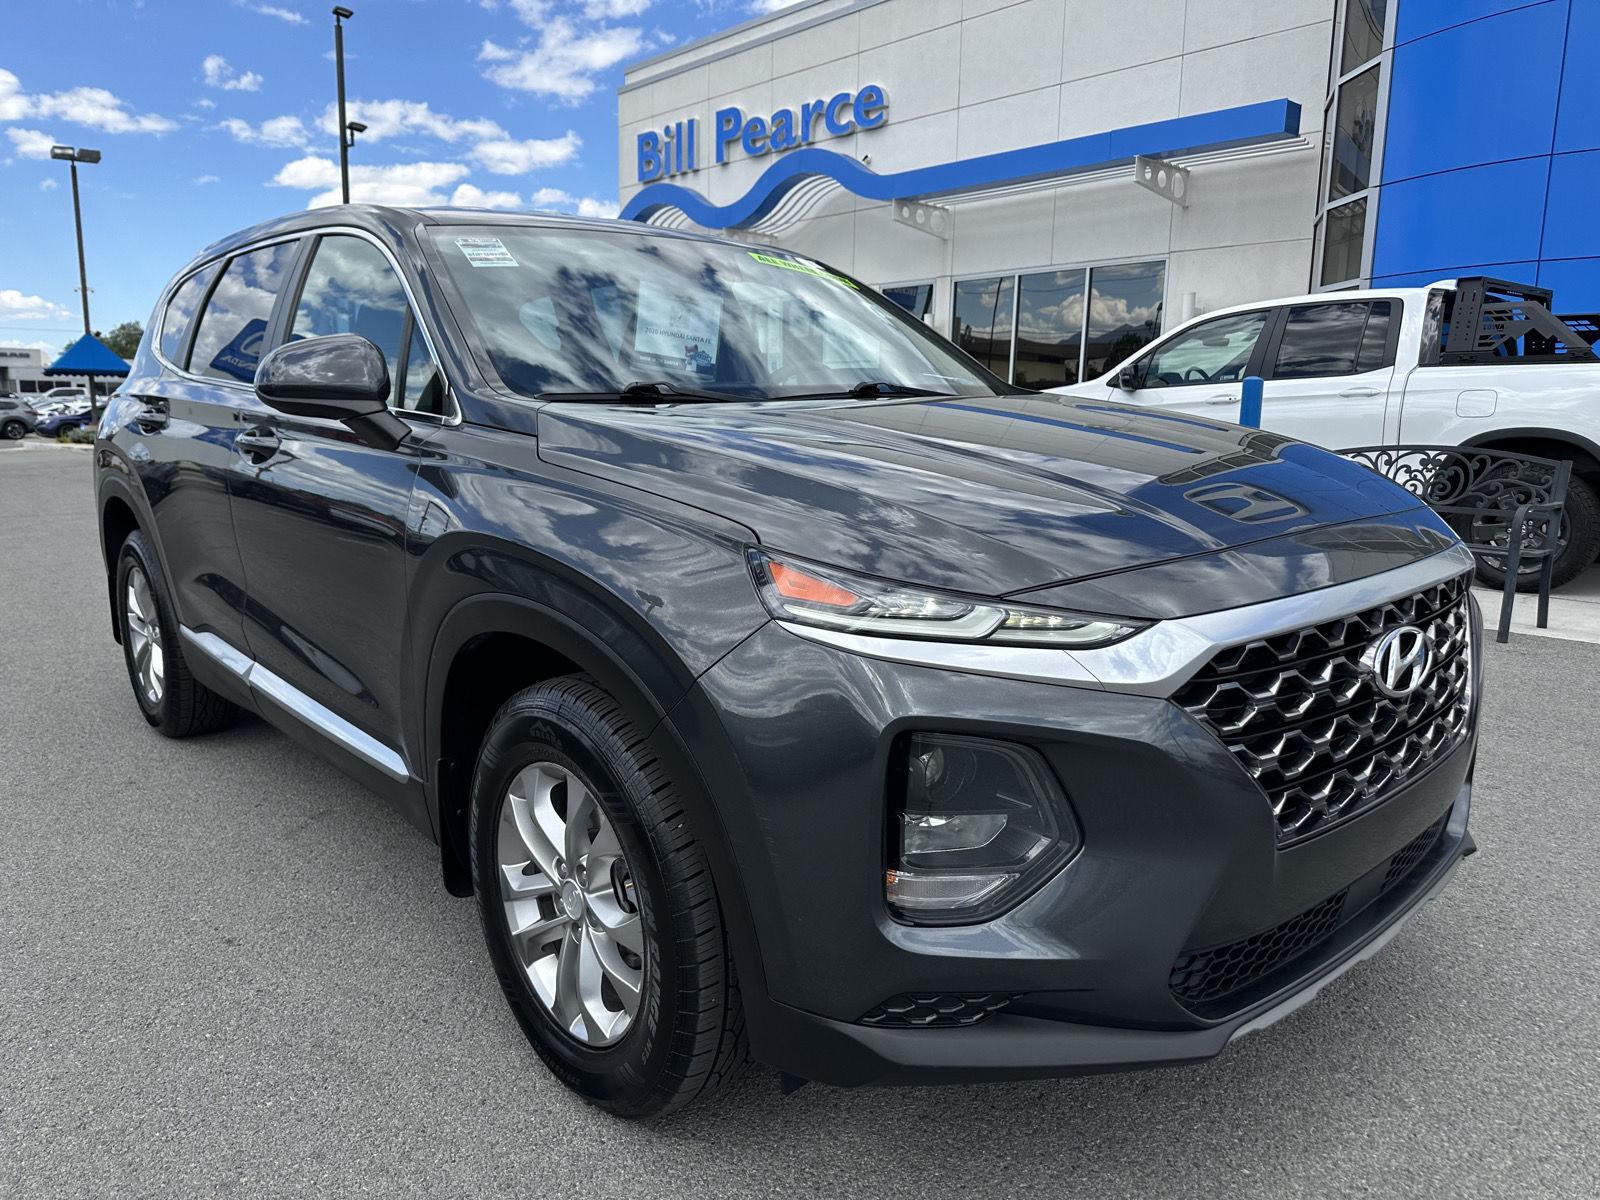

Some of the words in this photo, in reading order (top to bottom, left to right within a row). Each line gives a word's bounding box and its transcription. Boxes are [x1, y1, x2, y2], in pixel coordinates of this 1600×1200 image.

[637, 118, 696, 182] Bill
[715, 84, 887, 164] Pearce
[645, 327, 658, 336] 2020
[659, 330, 685, 340] HYUNDAI
[686, 335, 704, 344] SANTA
